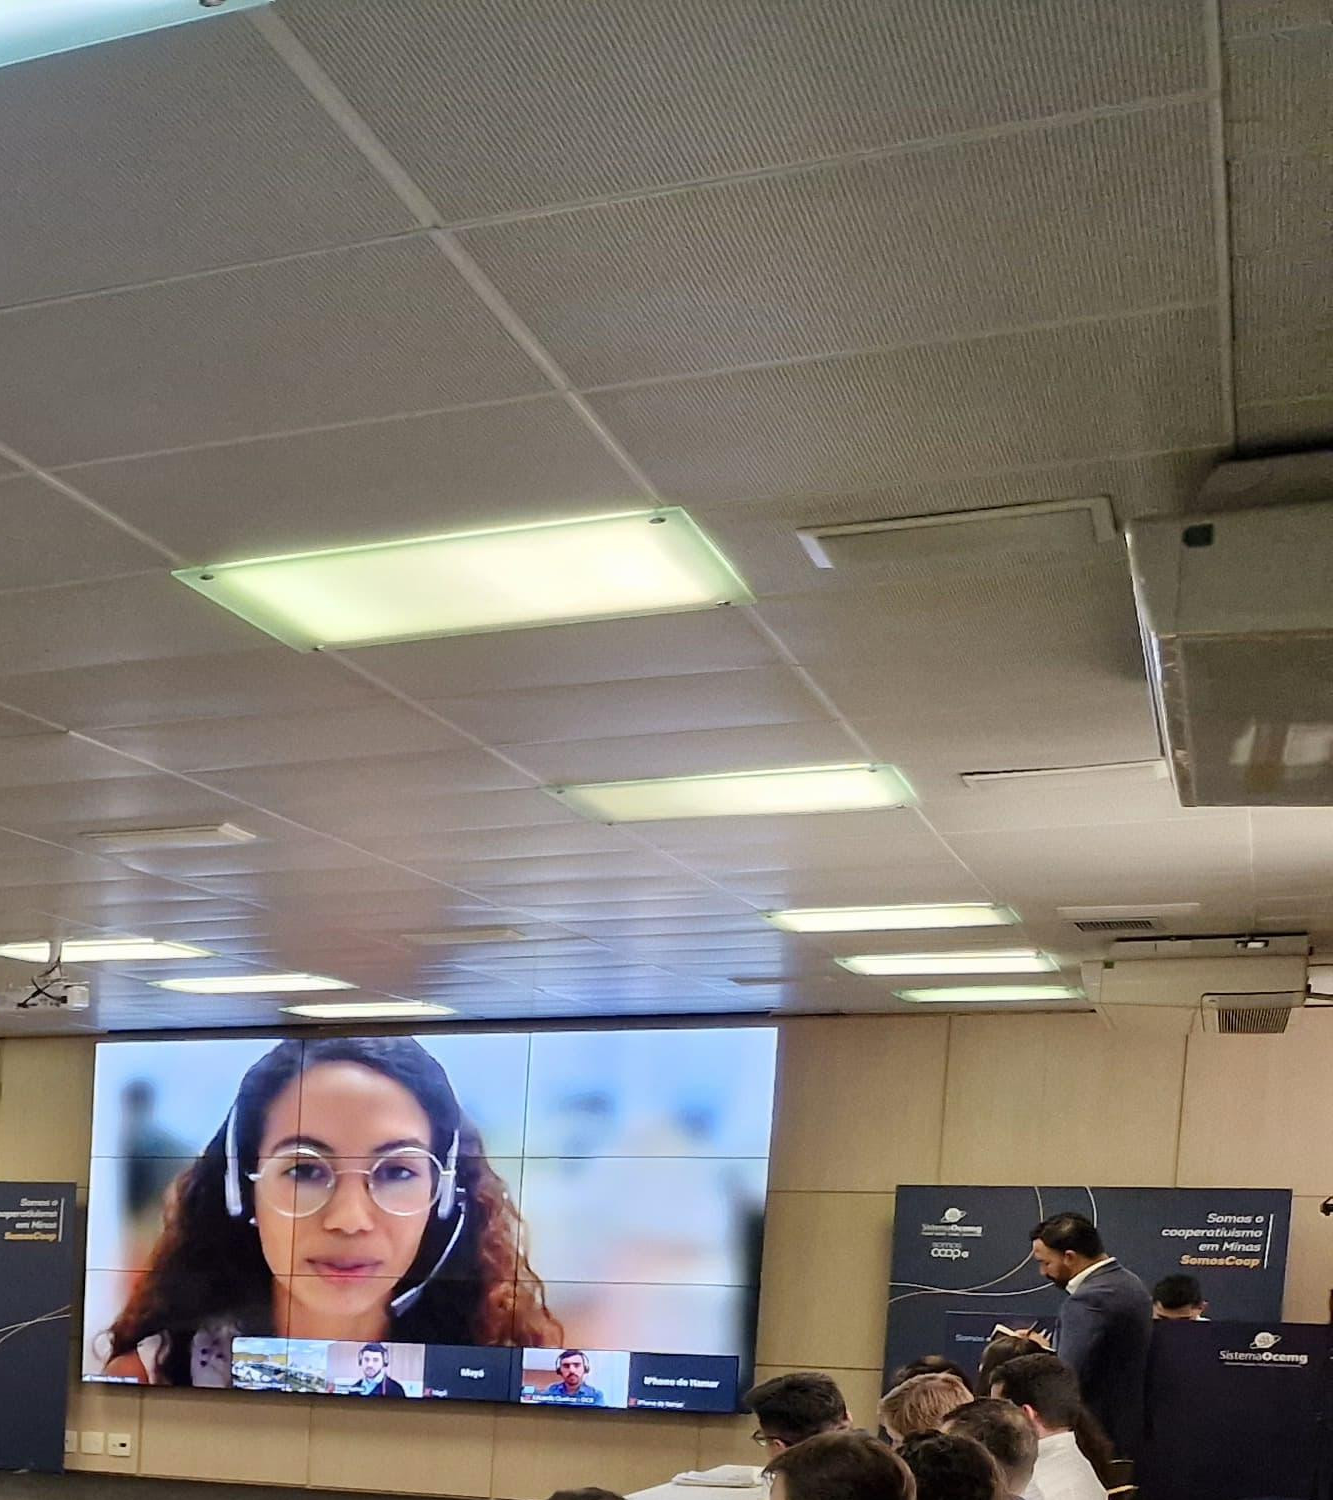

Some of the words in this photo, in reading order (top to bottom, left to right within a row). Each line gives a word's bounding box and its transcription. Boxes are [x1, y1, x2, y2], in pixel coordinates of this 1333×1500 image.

[1206, 1212, 1253, 1224] Somos
[1254, 1215, 1265, 1224] o
[1198, 1243, 1219, 1252] em
[1221, 1241, 1262, 1252] Minas
[1180, 1254, 1261, 1268] SomosCoop
[1219, 1350, 1309, 1365] SistemaOcemg
